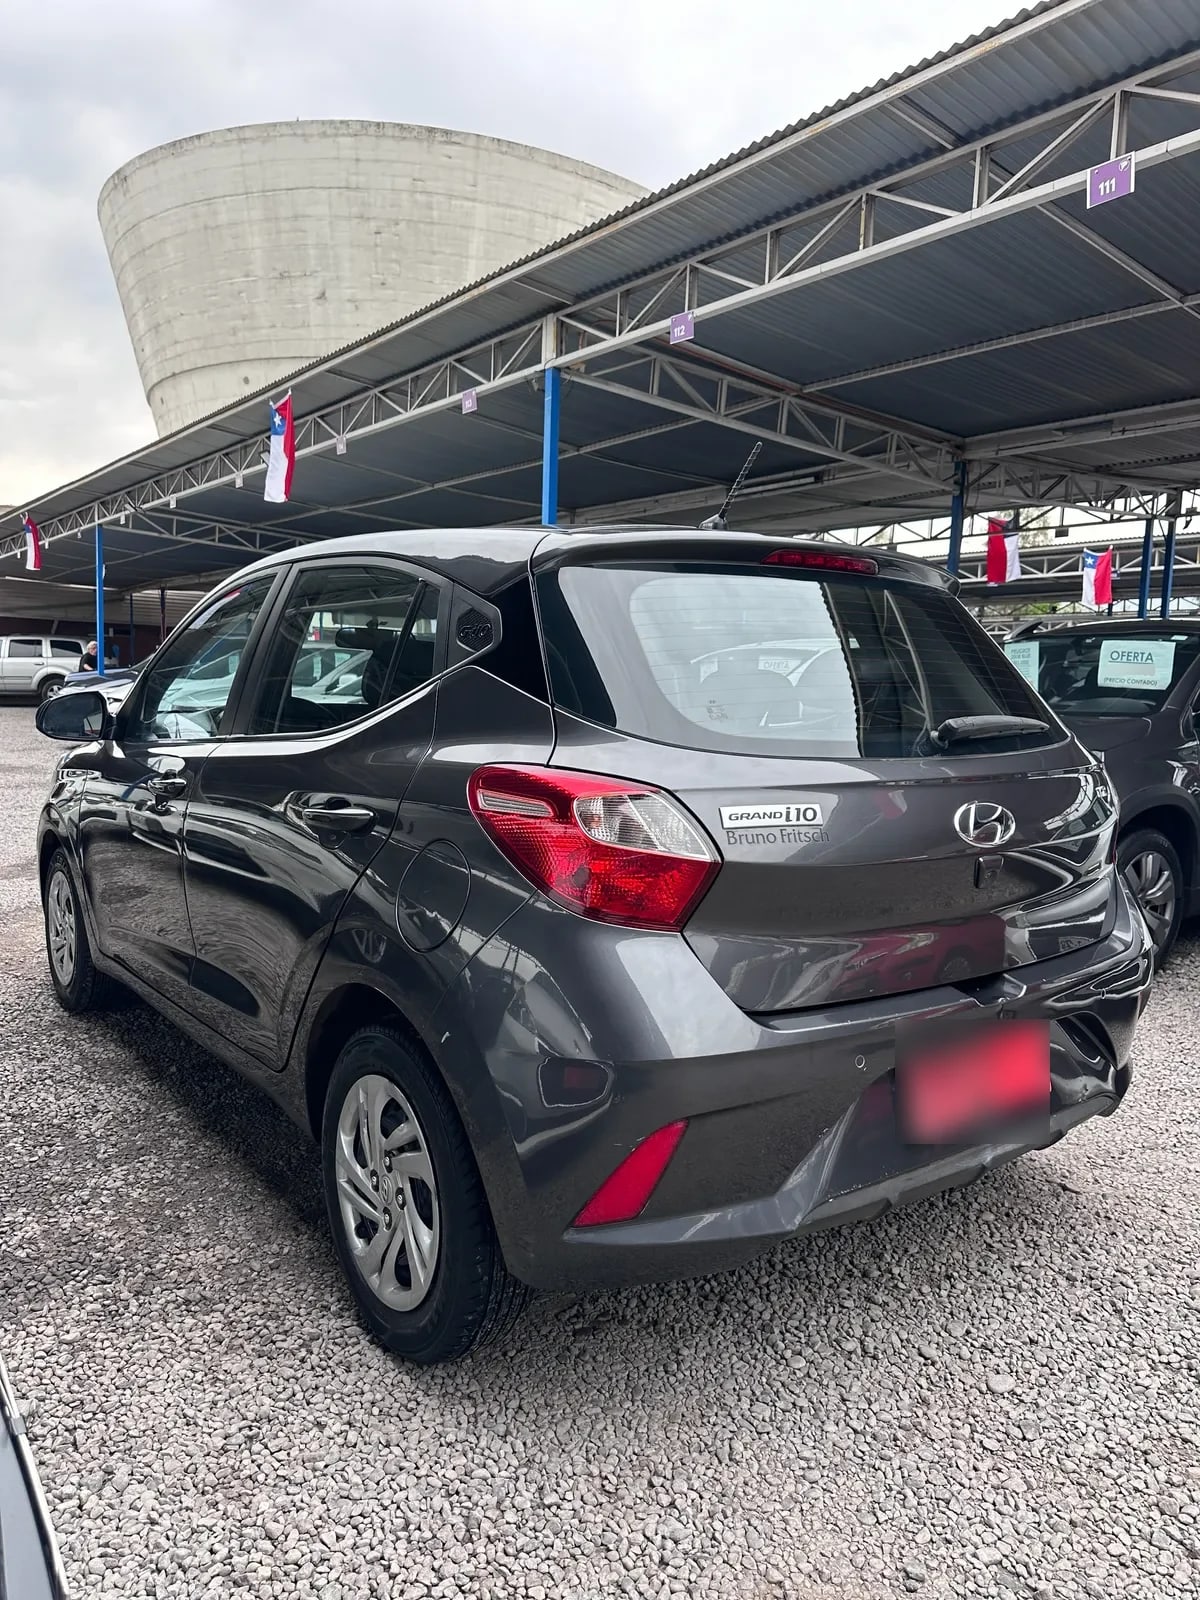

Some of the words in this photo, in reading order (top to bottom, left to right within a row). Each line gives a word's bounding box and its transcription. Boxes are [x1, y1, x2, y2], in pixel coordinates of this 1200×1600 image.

[1098, 177, 1116, 196] 111
[674, 325, 686, 338] 112
[1110, 650, 1154, 663] OFERTA
[1126, 678, 1158, 687] CONTADO)
[728, 811, 783, 821] GRAND
[784, 806, 818, 823] i10
[726, 830, 777, 845] Bruno
[779, 828, 830, 843] Fritsch
